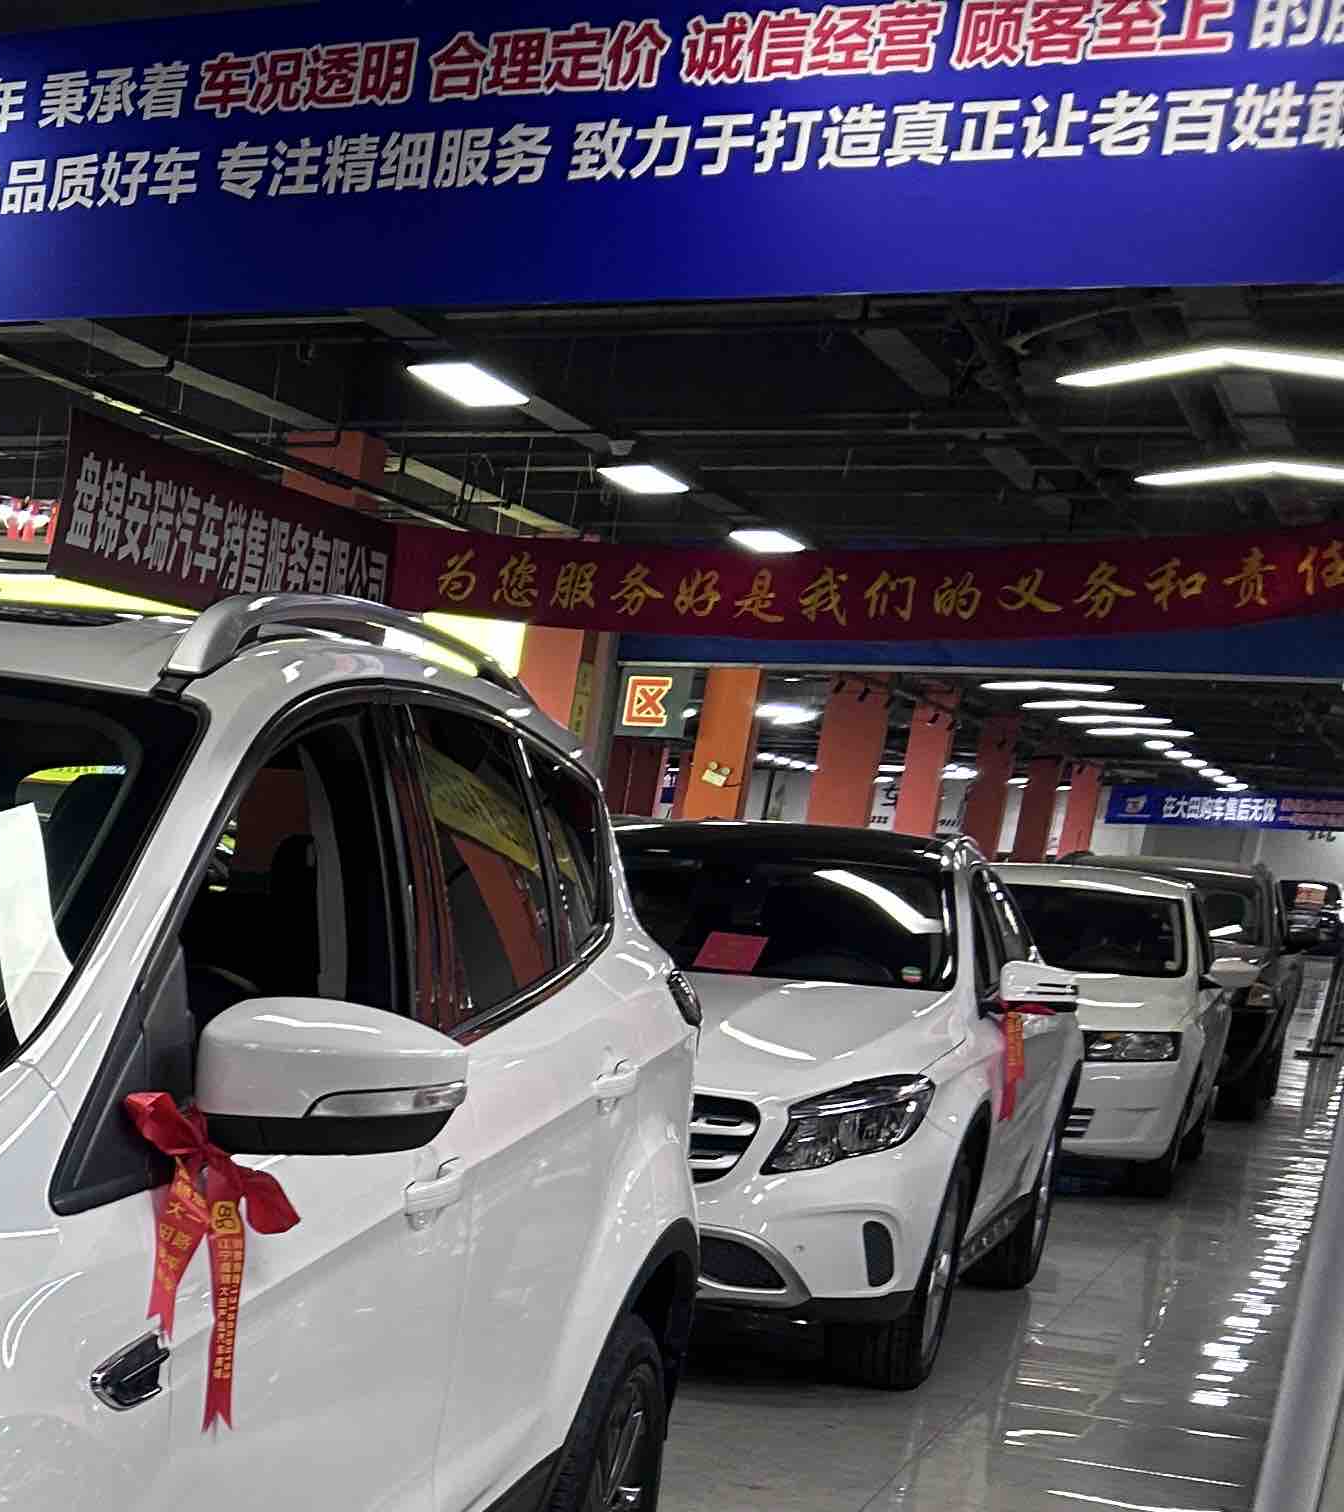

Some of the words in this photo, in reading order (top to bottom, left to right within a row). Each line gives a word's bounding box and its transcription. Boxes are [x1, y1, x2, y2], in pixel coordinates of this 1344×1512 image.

[38, 61, 190, 129] 秉承着
[195, 38, 419, 118] 车况透明
[429, 17, 670, 102] 合理定价
[681, 0, 946, 86] 诚信经营
[950, 0, 1233, 71] 顾客至上
[215, 123, 553, 200] 专注精细服务
